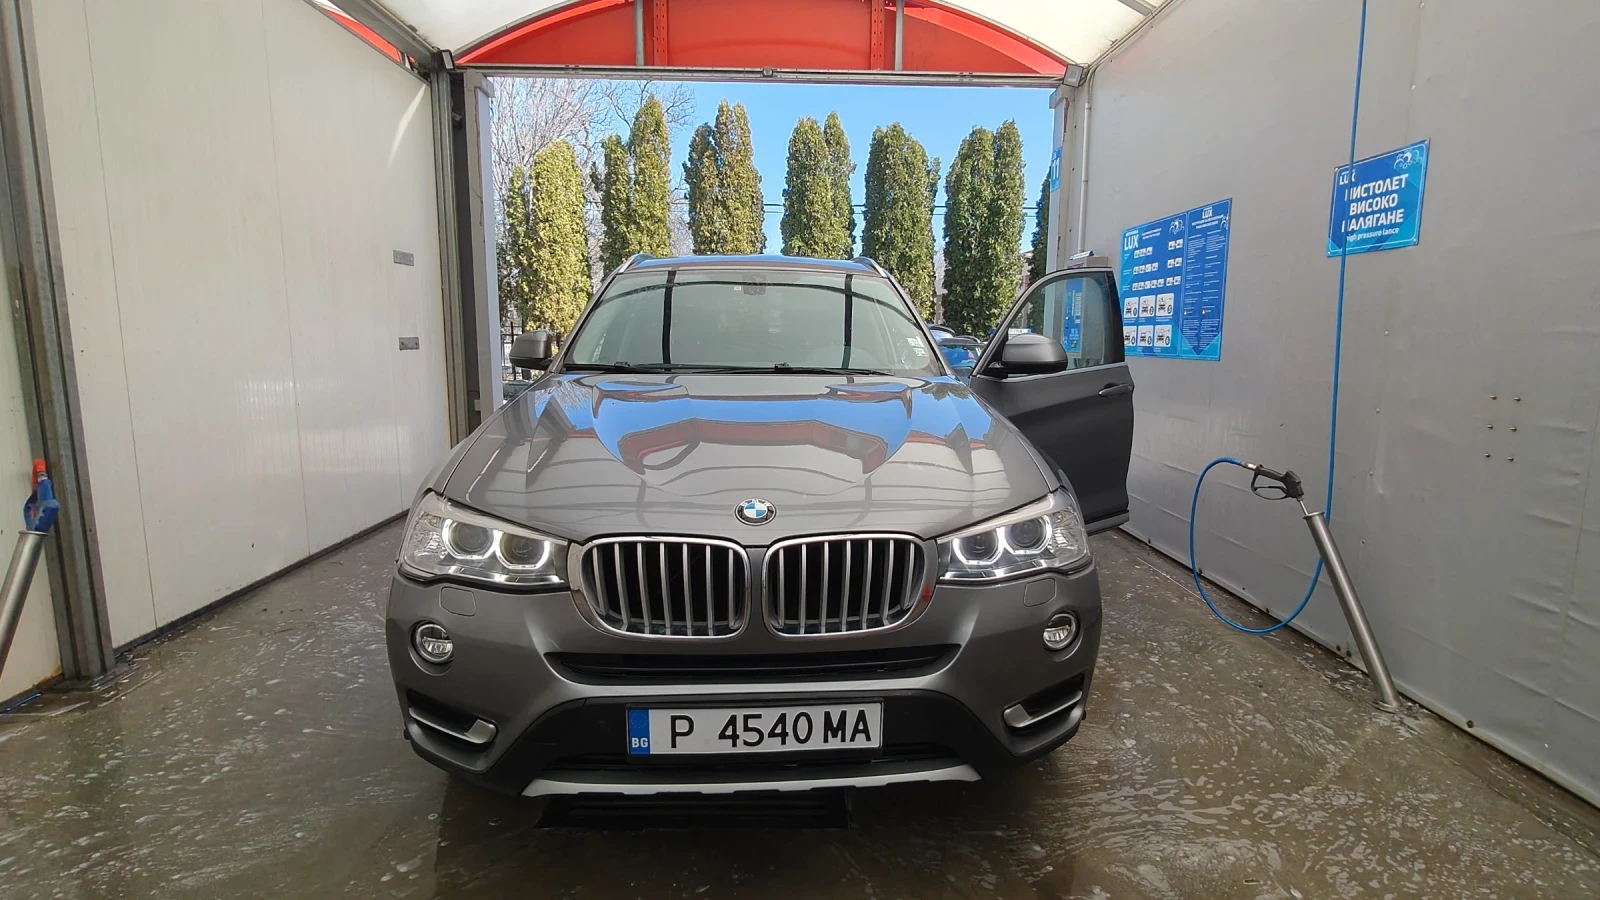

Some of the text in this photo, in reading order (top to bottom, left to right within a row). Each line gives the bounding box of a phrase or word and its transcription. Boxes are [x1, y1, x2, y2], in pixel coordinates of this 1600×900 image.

[1350, 194, 1398, 215] ВИСОКО
[1202, 209, 1212, 219] LUX
[1357, 229, 1382, 241] pressure
[1383, 227, 1399, 235] lance
[1124, 234, 1139, 250] LUX
[669, 709, 872, 749] P 4540 MA
[631, 737, 649, 748] BG
